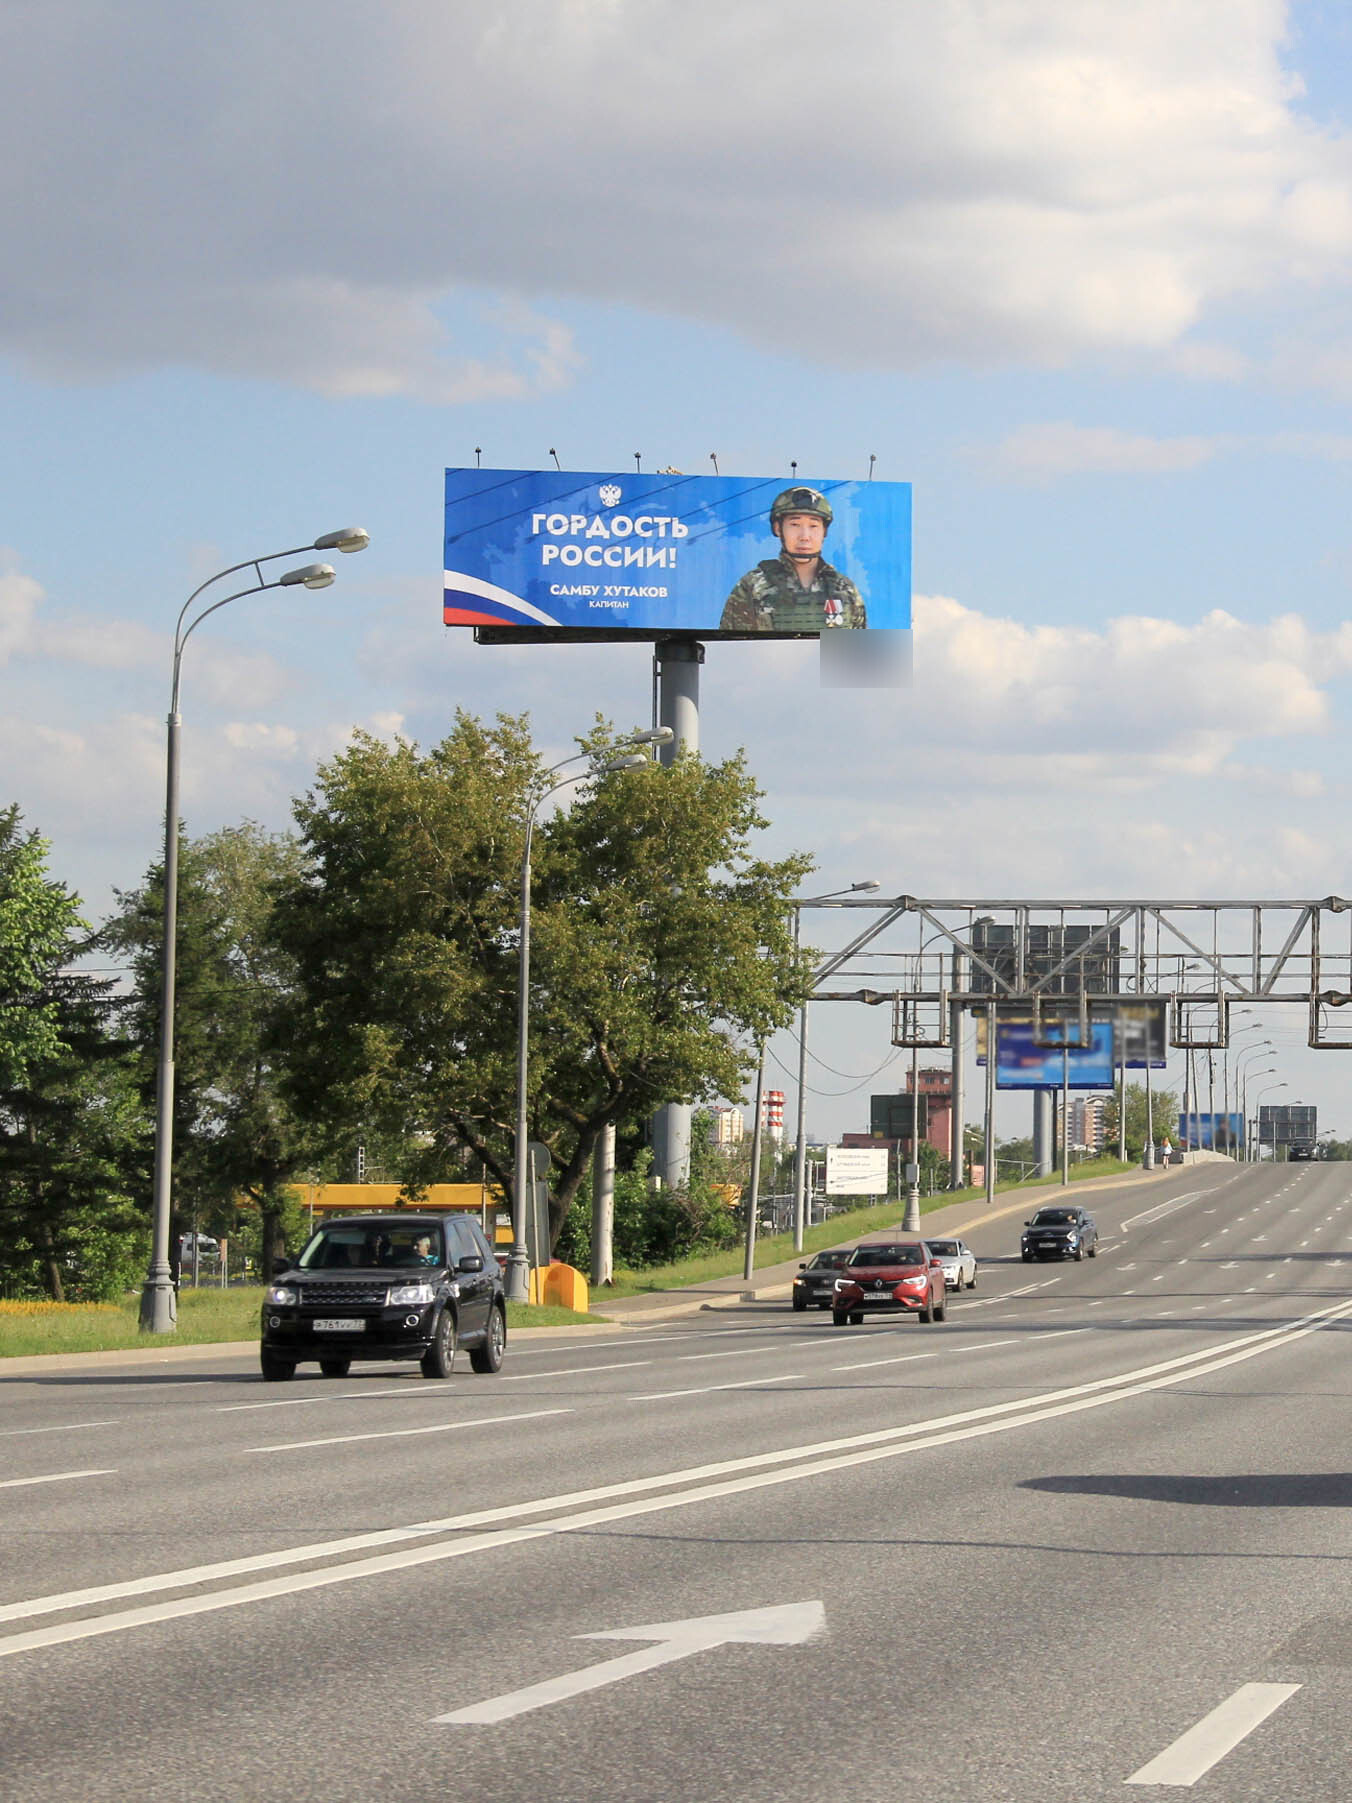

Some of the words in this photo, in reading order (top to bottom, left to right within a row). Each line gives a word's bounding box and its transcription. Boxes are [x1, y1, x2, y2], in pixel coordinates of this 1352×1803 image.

[532, 513, 689, 539] ГОРДОСТЬ
[542, 544, 677, 568] РОССИИ!
[550, 584, 600, 596] САМБУ
[603, 585, 668, 597] ХУТАКОВ
[589, 600, 629, 609] КАПИТАН
